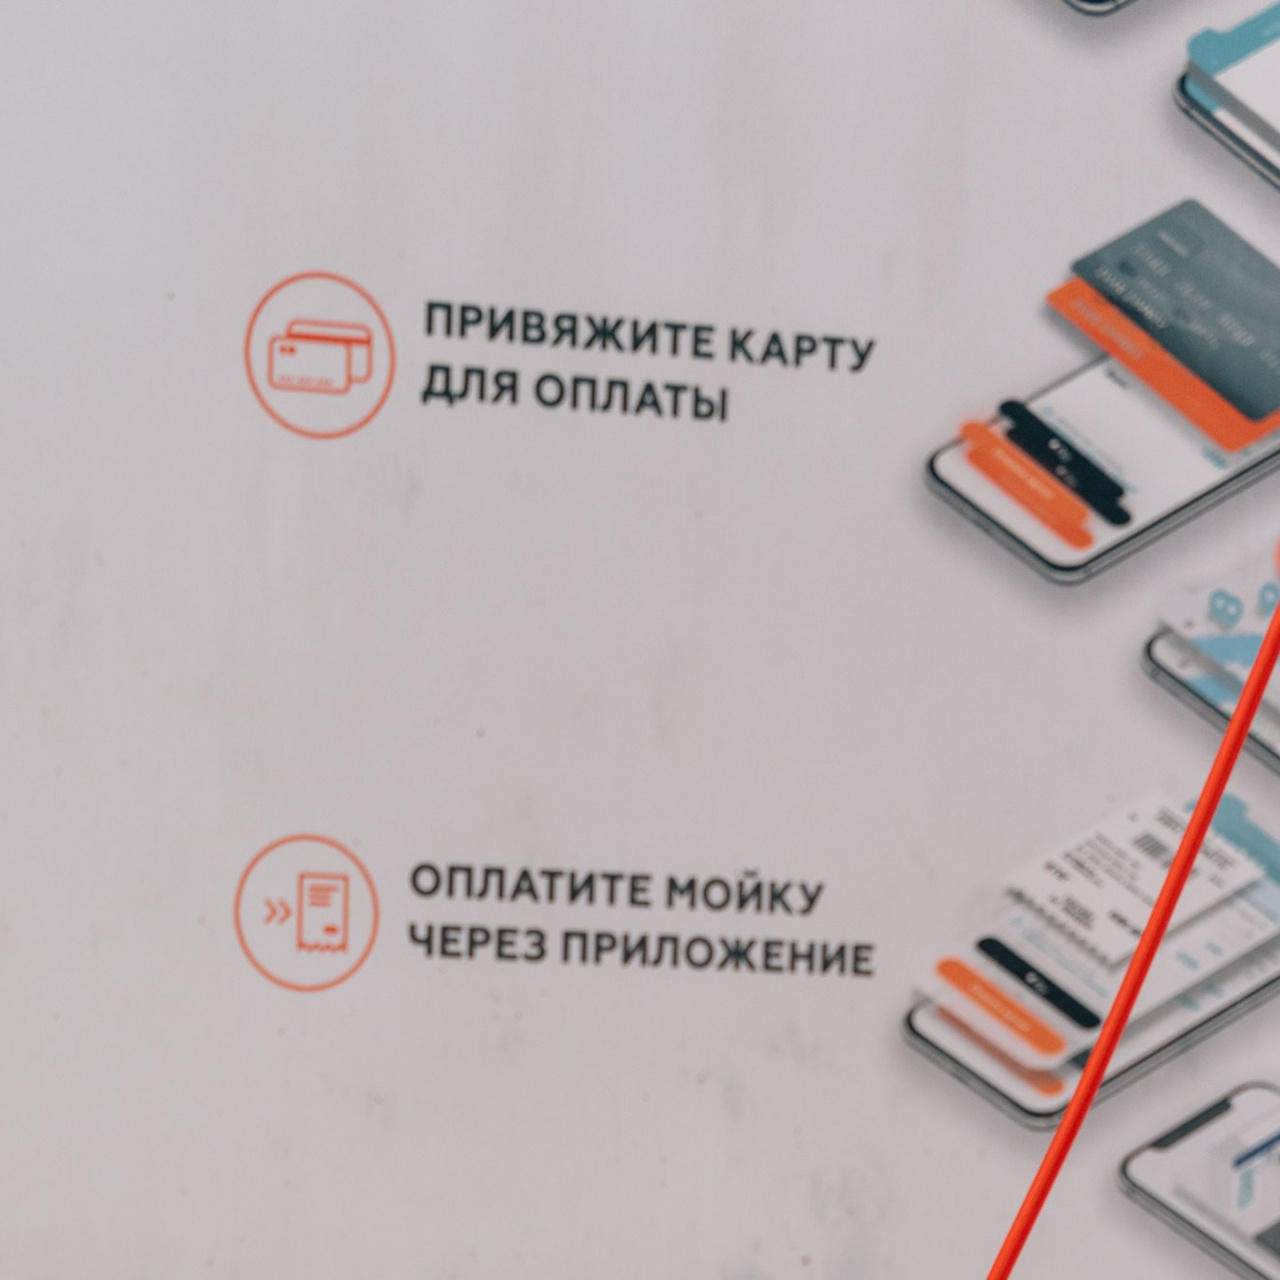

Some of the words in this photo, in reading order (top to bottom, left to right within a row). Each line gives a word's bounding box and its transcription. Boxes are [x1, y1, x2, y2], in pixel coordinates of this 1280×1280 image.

[425, 300, 716, 361] ПРИВЯЖИТЕ
[729, 327, 876, 373] КАРТУ
[420, 363, 520, 406] ДЛЯ
[533, 372, 729, 422] ОПЛАТЫ
[409, 862, 652, 908] ОПЛАТИТЕ
[666, 867, 825, 916] МОЙКУ
[408, 923, 548, 963] ЧЕРЕЗ
[561, 929, 875, 977] ПРИЛОЖЕНИЕ
